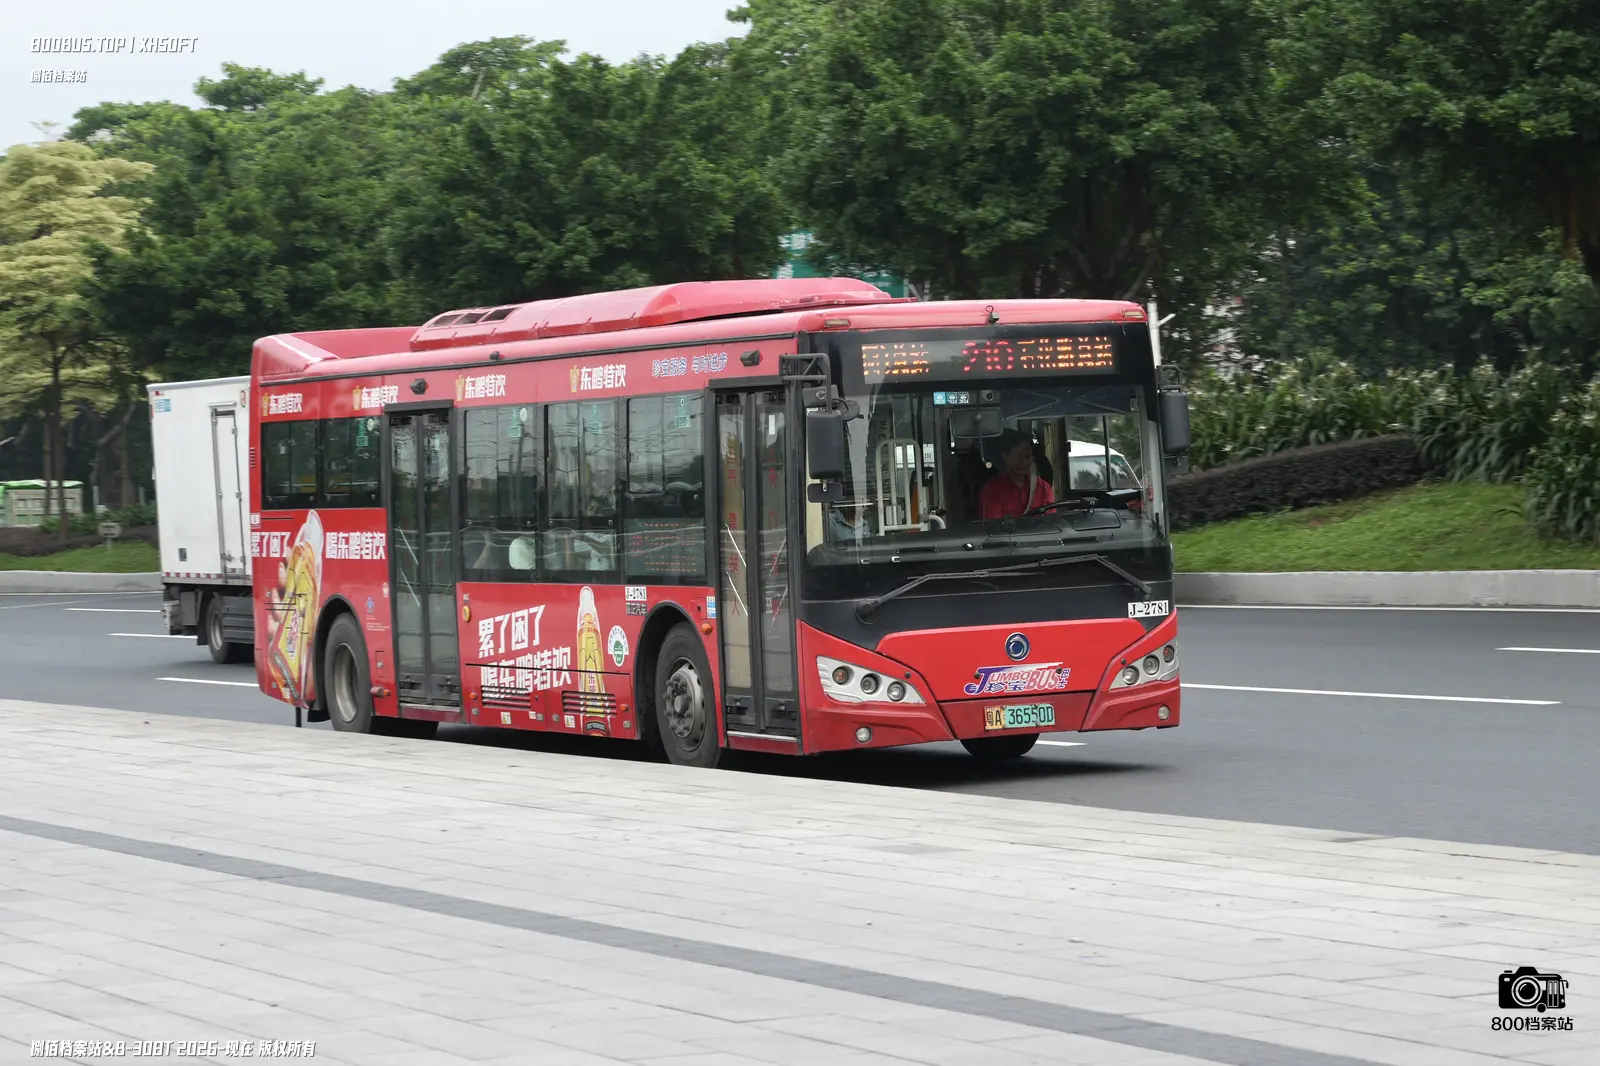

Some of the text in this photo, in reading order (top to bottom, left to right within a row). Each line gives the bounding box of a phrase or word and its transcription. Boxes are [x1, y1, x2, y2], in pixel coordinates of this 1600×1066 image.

[464, 374, 506, 400] 东鹏特饮
[580, 364, 627, 391] 东鹏特饮
[269, 392, 303, 414] 东鹏特饮
[361, 385, 399, 408] 东鹏特饮
[325, 531, 386, 560] 喝东鹏特饮
[1129, 601, 1168, 616] J-2781
[478, 604, 546, 659] 累了困了
[480, 646, 572, 698] 喝东鹏特饮
[984, 681, 1027, 693] 珍宝
